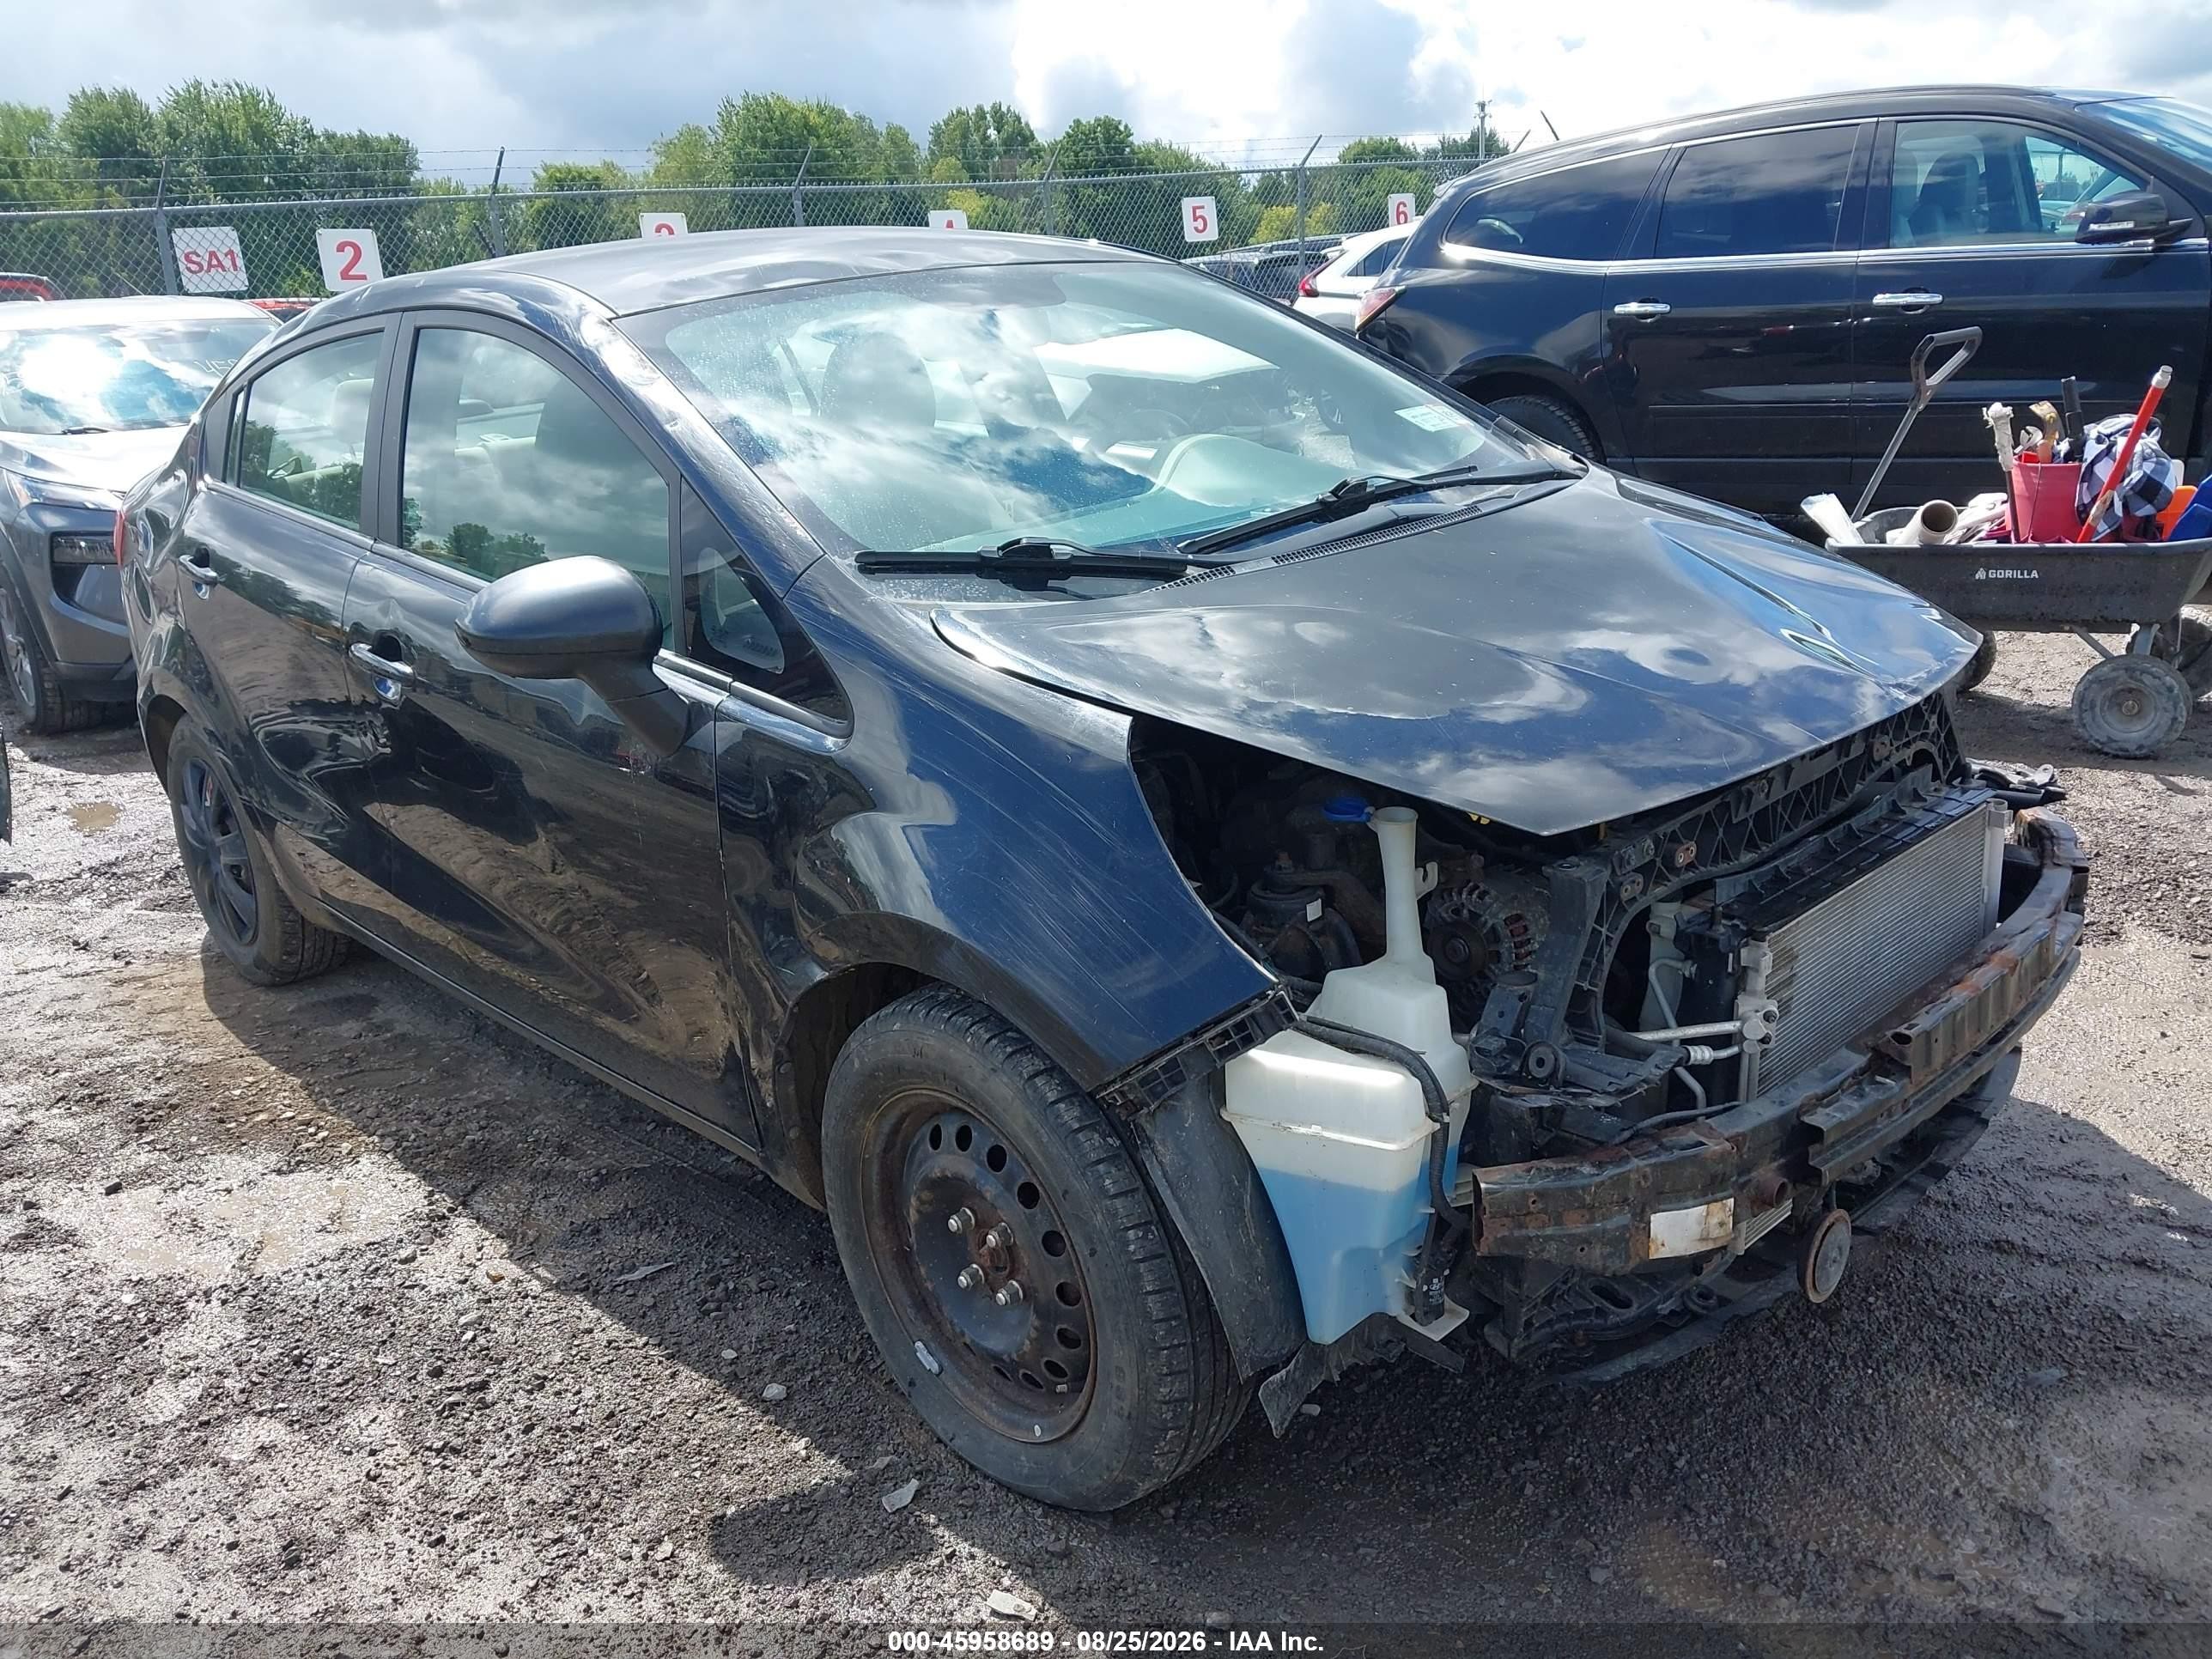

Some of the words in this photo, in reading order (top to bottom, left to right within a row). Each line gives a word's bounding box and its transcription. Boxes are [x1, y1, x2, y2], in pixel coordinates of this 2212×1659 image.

[1192, 205, 1207, 234] 5
[1395, 201, 1408, 225] 6
[184, 249, 239, 275] SA1
[336, 240, 368, 281] 2
[1988, 569, 2039, 579] GORILLA
